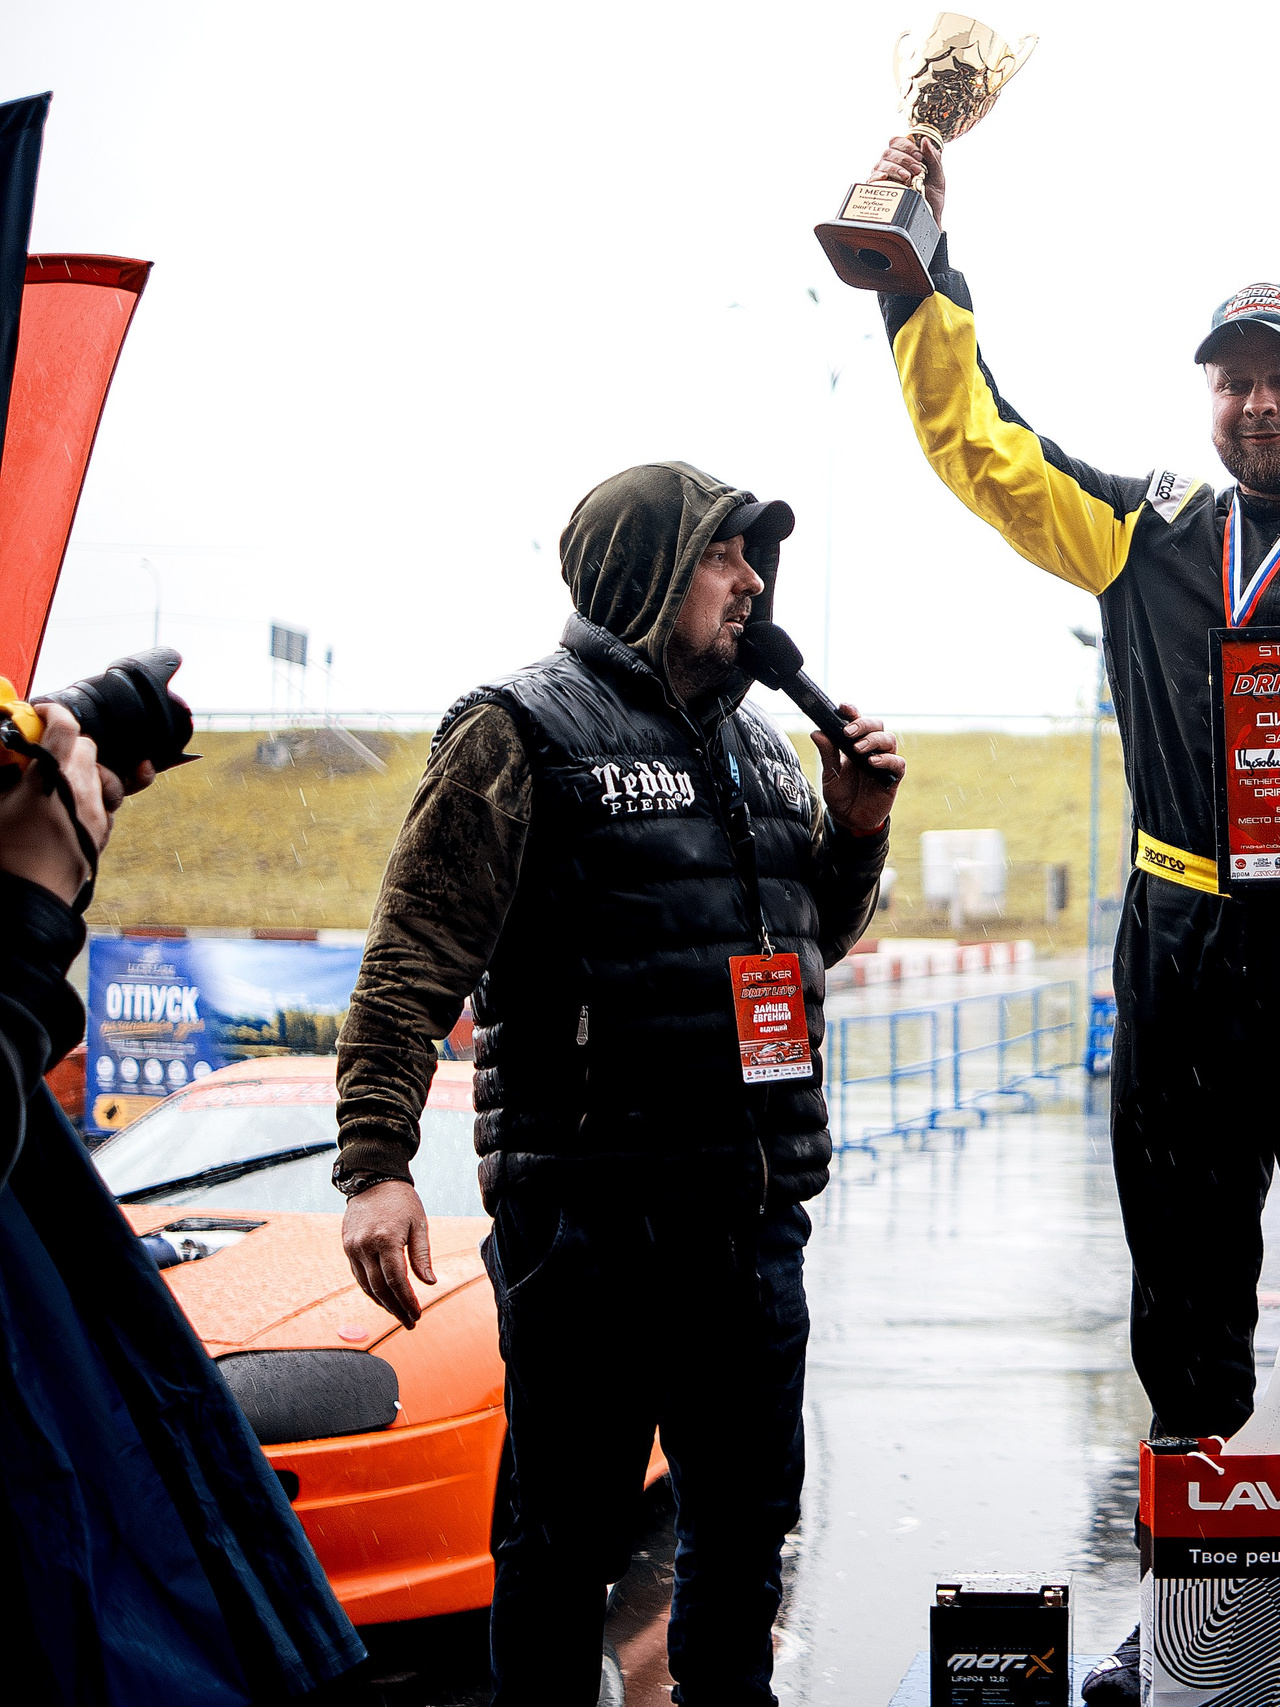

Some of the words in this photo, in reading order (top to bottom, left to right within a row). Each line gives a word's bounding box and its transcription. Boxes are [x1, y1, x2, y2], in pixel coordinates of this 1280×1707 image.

[864, 188, 898, 198] МЕСТО
[1159, 472, 1178, 500] arco
[591, 760, 696, 808] Teddy
[609, 796, 678, 816] PLEIN
[1238, 816, 1272, 825] МЕСТО
[1144, 846, 1186, 873] sparco
[741, 986, 772, 999] DRIFT
[772, 984, 797, 997] LETO
[106, 982, 200, 1024] ОТПУСК
[754, 1001, 790, 1014] ЗАЙЦЕВ
[1188, 1548, 1238, 1564] Твое
[946, 1646, 1055, 1679] MOT-X
